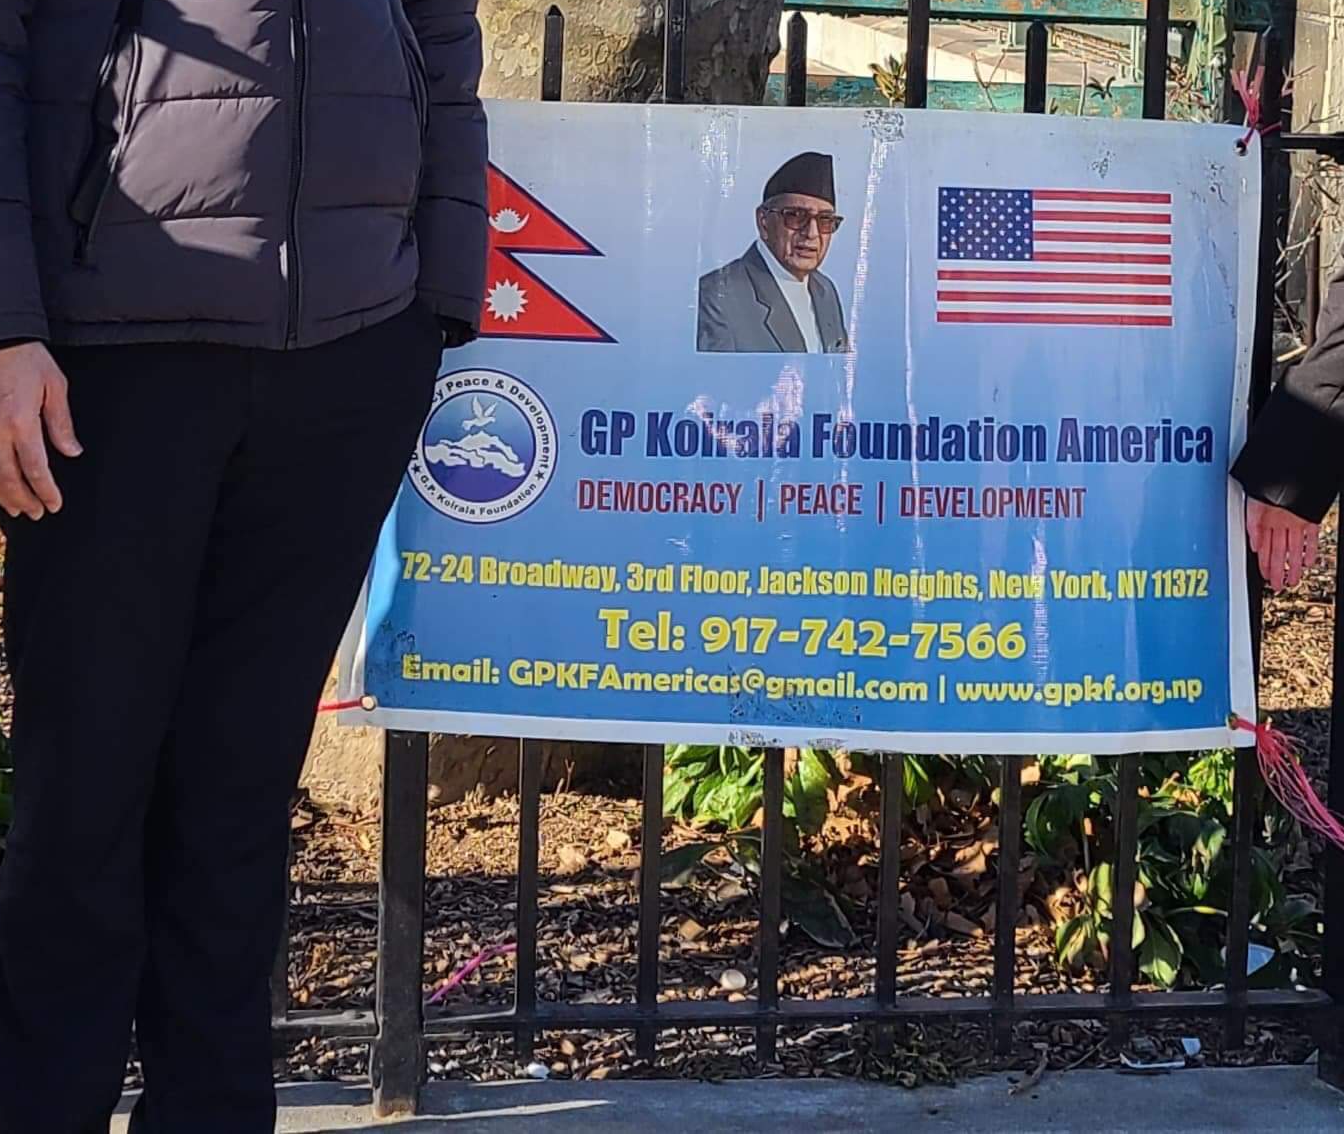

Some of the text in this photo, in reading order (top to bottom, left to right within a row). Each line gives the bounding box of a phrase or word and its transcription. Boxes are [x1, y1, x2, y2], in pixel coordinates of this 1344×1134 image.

[446, 377, 490, 393] Peace
[509, 384, 551, 470] Development
[581, 408, 1214, 464] GP Koirala Foundation America
[419, 474, 538, 516] G.P. Koirala Foundation
[578, 479, 743, 515] DEMOCRACY
[780, 483, 863, 515] PEACE
[900, 486, 1087, 518] DEVELOPMENT
[401, 552, 1209, 602] 72-24 Broadway, 3rd Floor, Jackson Heights, New York, NY 11372
[598, 608, 1027, 661] Tel: 917-742-7566
[401, 653, 500, 684] Email:
[508, 657, 929, 702] GPKFAmericas@gmail.com
[956, 675, 1203, 707] www.gpkf.org.np
